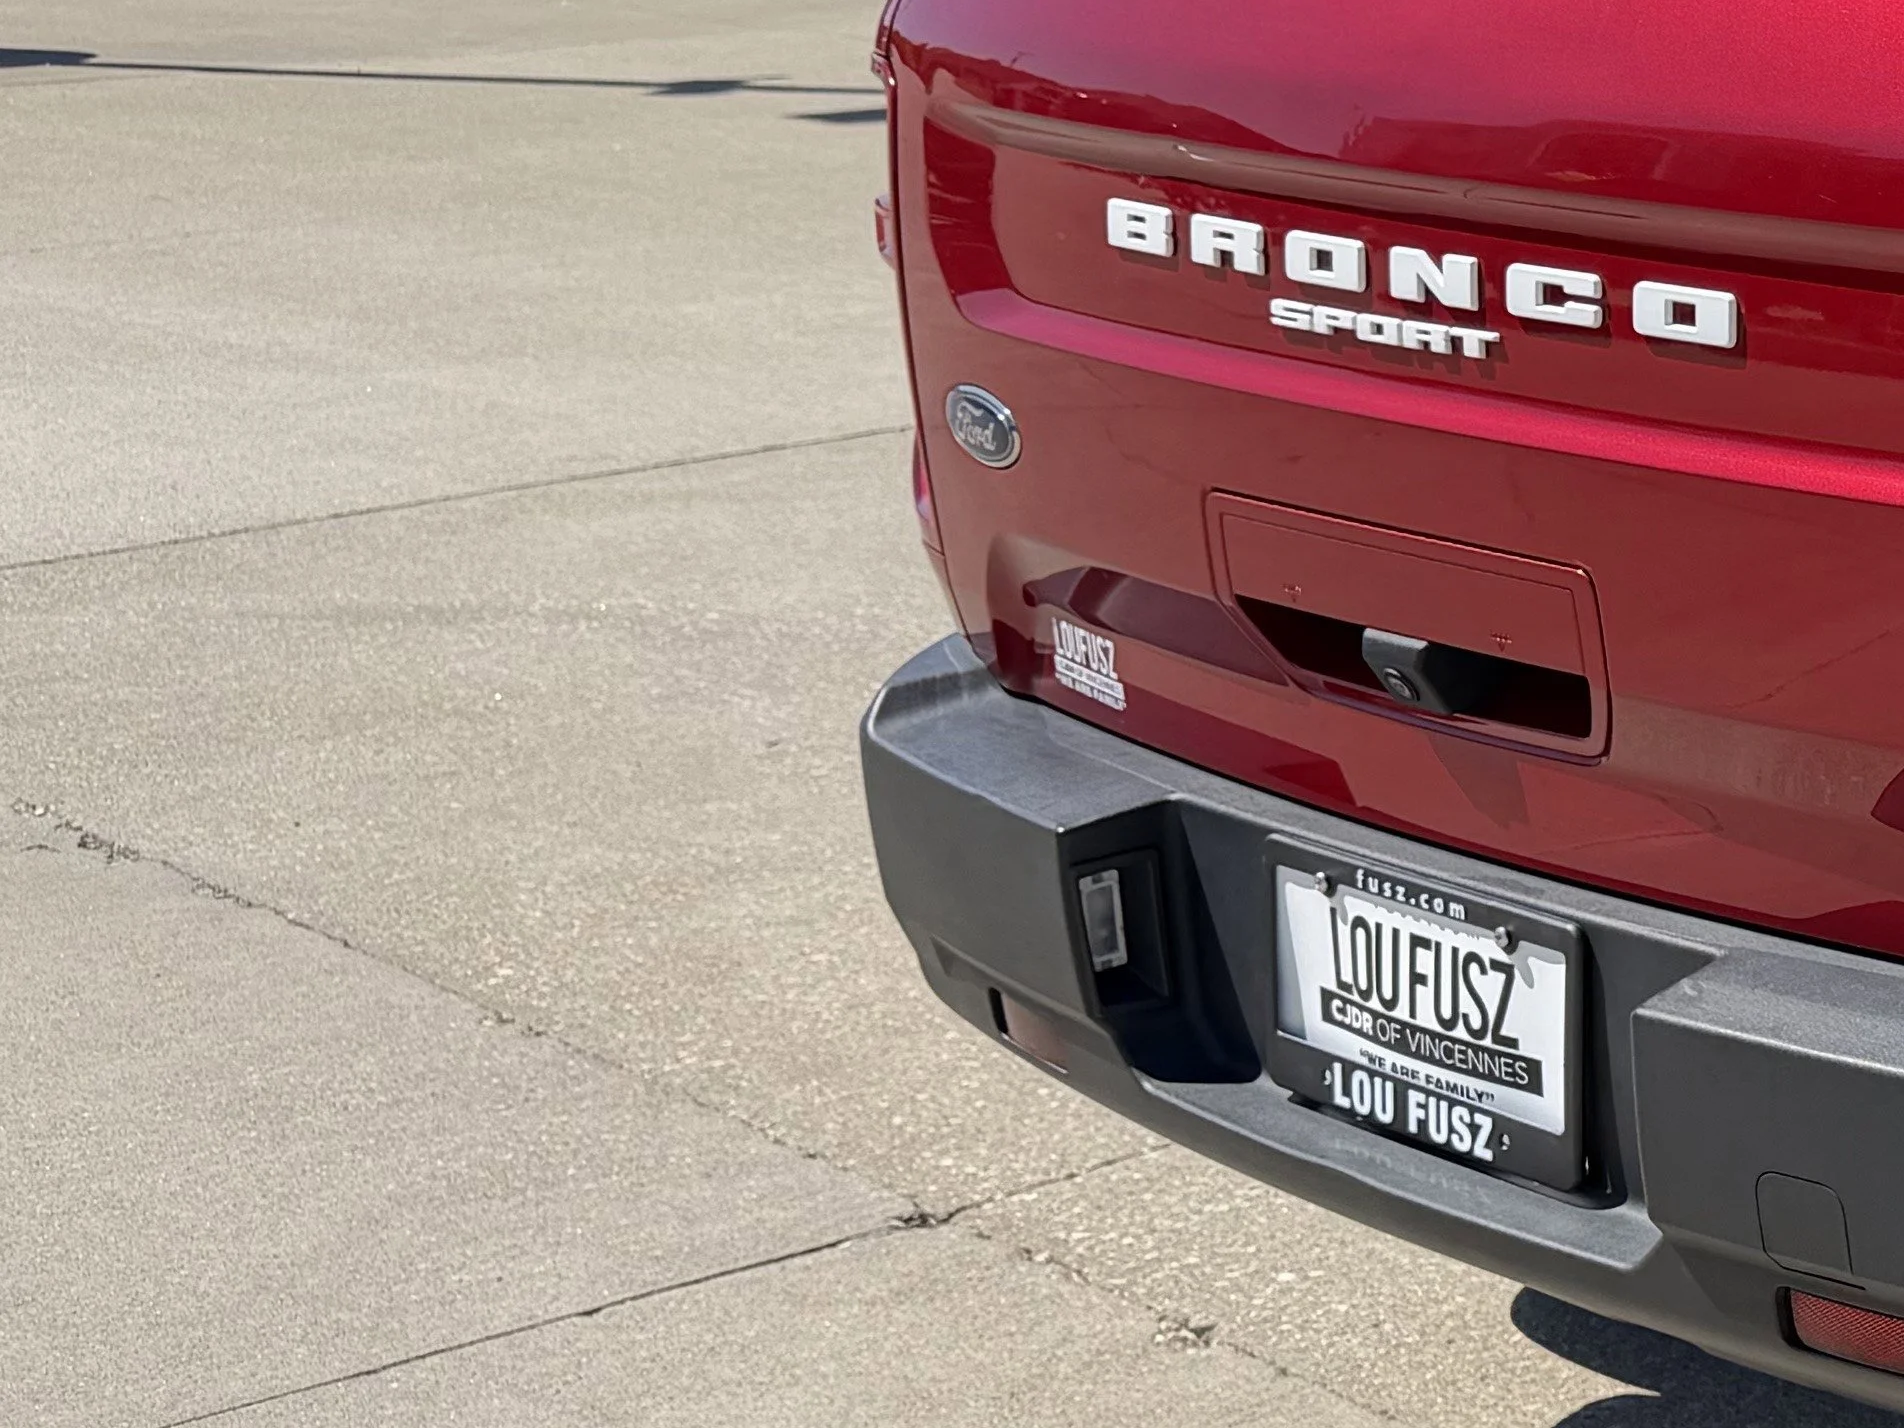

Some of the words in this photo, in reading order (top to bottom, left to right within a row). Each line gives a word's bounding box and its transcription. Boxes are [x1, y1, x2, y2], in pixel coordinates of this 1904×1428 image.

[1107, 197, 1737, 349] BRONCO
[1269, 298, 1500, 359] SPORT
[1356, 869, 1466, 921] fusz.com
[1331, 999, 1373, 1035] CJDR
[1376, 1017, 1401, 1043] OF
[1406, 1028, 1529, 1086] VINCENNES
[1391, 1059, 1421, 1081] ARE
[1333, 1061, 1395, 1124] LOU
[1406, 1087, 1494, 1163] FUSZ
